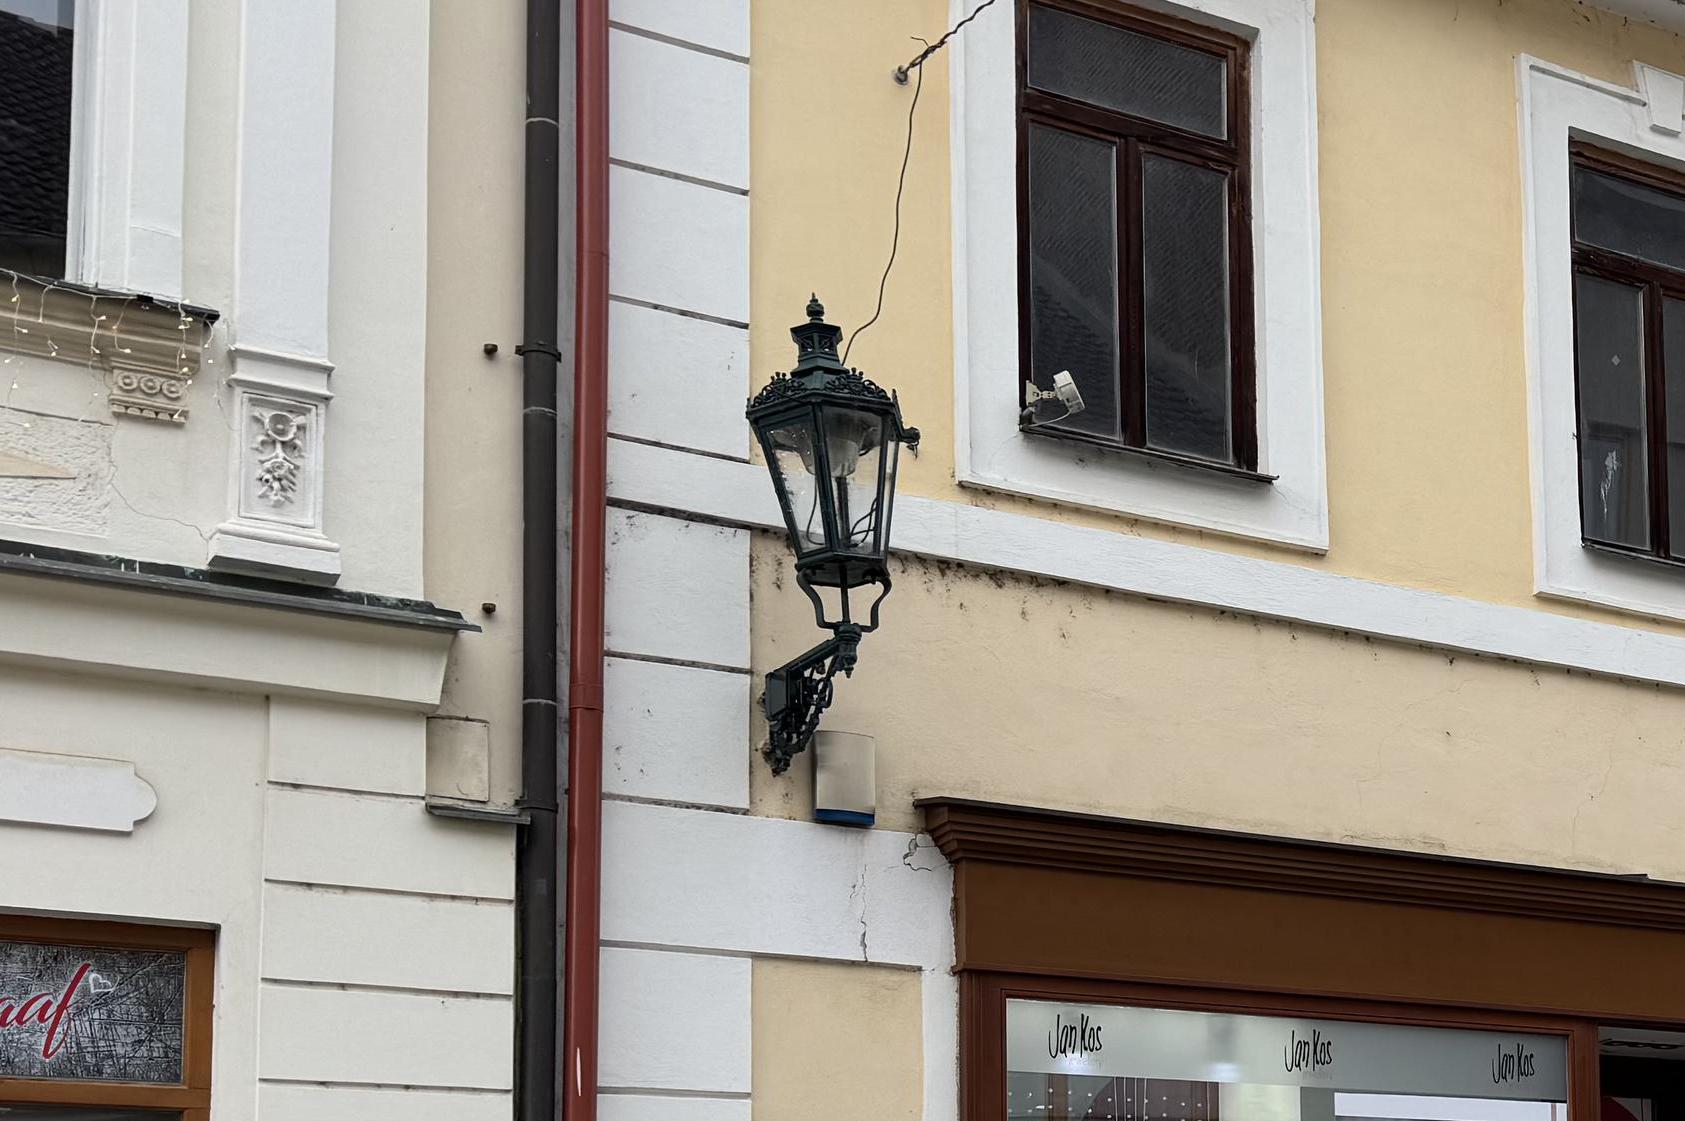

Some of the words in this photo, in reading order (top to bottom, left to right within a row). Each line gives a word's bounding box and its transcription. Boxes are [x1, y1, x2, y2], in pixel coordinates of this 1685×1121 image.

[1048, 1013, 1078, 1059] Jan
[1081, 1013, 1102, 1058] Kos
[1284, 1029, 1310, 1072] Jan
[1313, 1029, 1332, 1071] Kos
[1491, 1043, 1515, 1084] Jan
[1517, 1042, 1535, 1083] Kos
